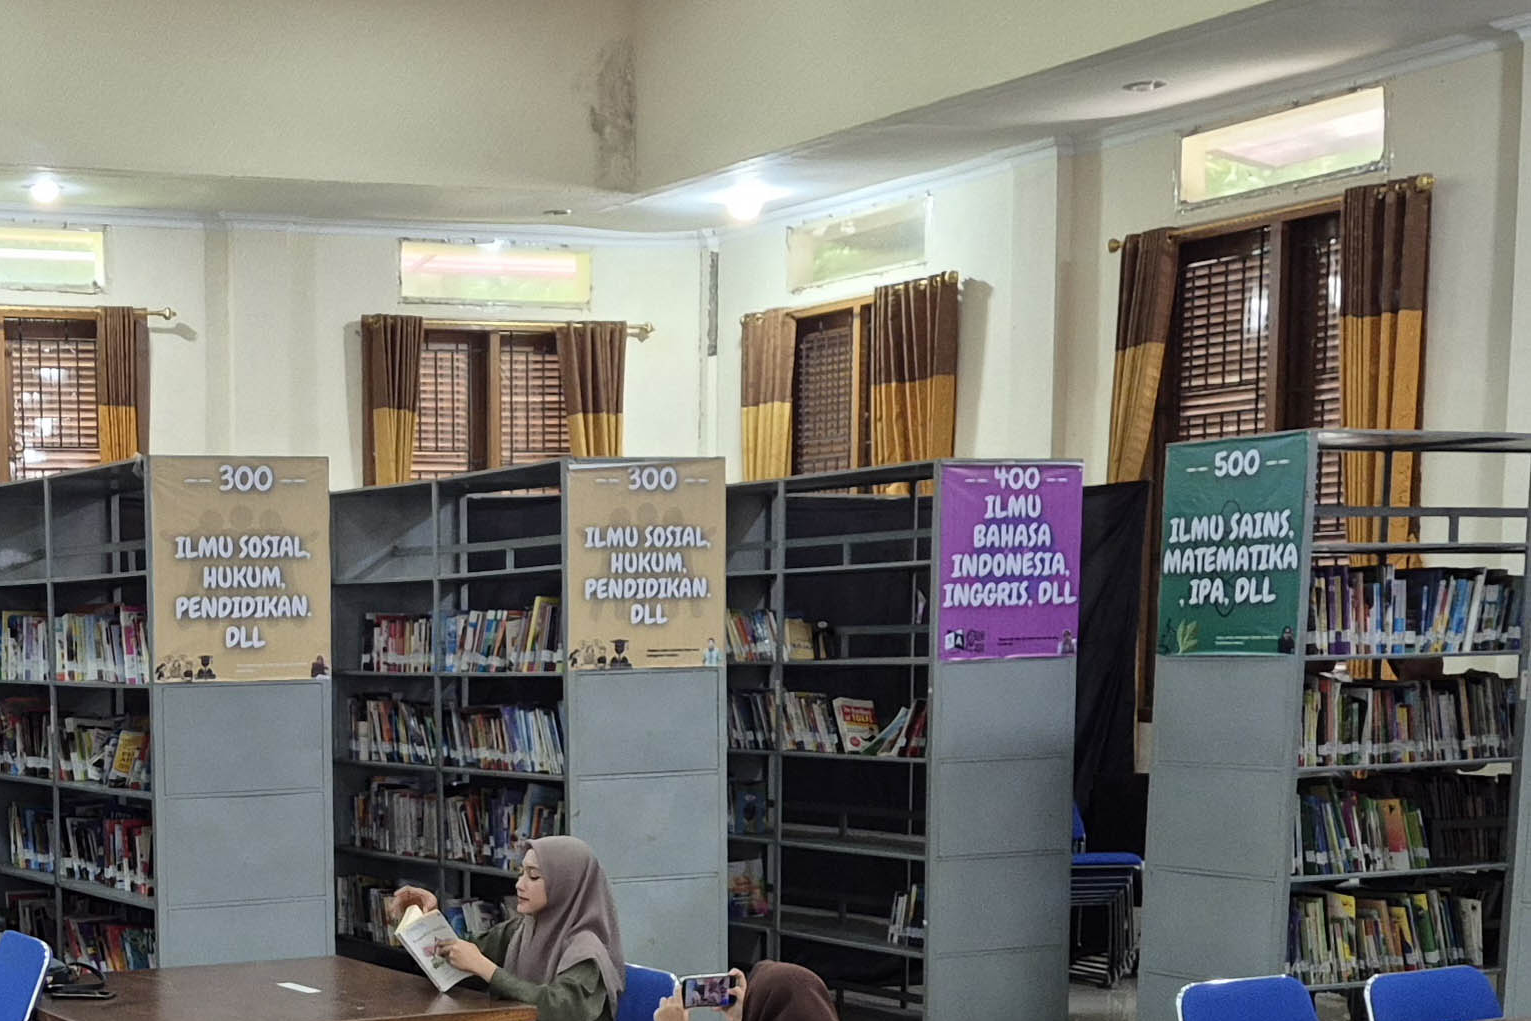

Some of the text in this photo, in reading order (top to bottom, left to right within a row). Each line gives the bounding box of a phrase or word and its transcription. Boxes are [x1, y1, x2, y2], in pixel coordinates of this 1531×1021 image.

[1214, 449, 1260, 477] 500
[219, 465, 273, 491] 300
[628, 466, 678, 491] 300
[994, 467, 1040, 490] 400
[984, 494, 1042, 519] ILMU
[584, 527, 638, 548] ILMU
[974, 523, 1051, 548] BAHASA
[1168, 514, 1224, 544] ILMU
[175, 536, 233, 559] ILMU
[1164, 543, 1298, 574] MATEMATIKA
[203, 566, 286, 589] HUKUM,
[1038, 581, 1077, 605] DLL
[1235, 577, 1276, 604] DLL
[631, 604, 668, 625] DLL
[226, 626, 266, 648] DLL
